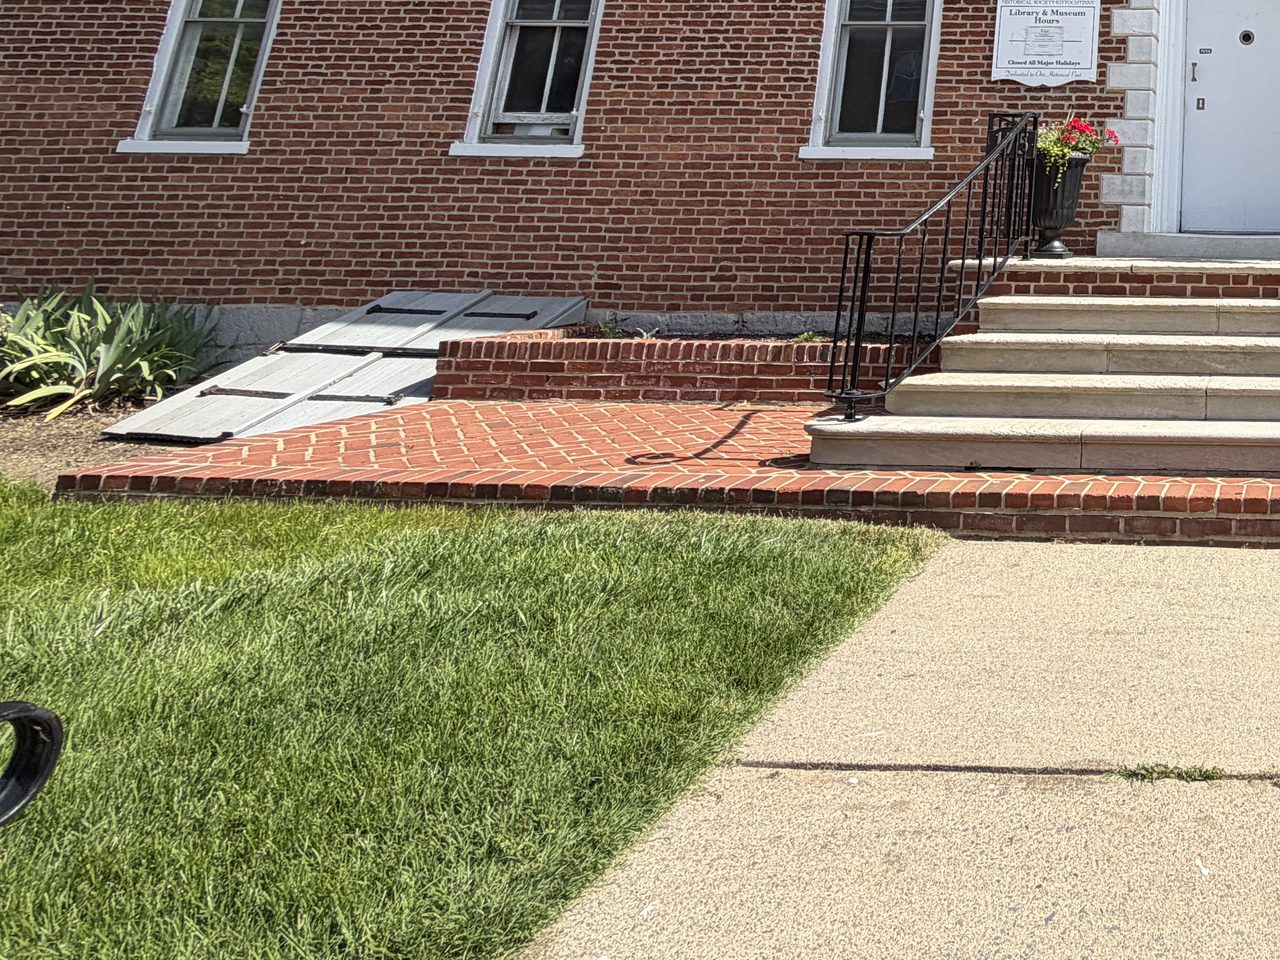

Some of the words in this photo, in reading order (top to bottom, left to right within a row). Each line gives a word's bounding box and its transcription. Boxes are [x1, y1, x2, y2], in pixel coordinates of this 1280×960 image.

[1009, 9, 1039, 17] Library
[1042, 9, 1048, 17] &
[1050, 9, 1086, 17] Museum
[1034, 16, 1060, 24] Hours
